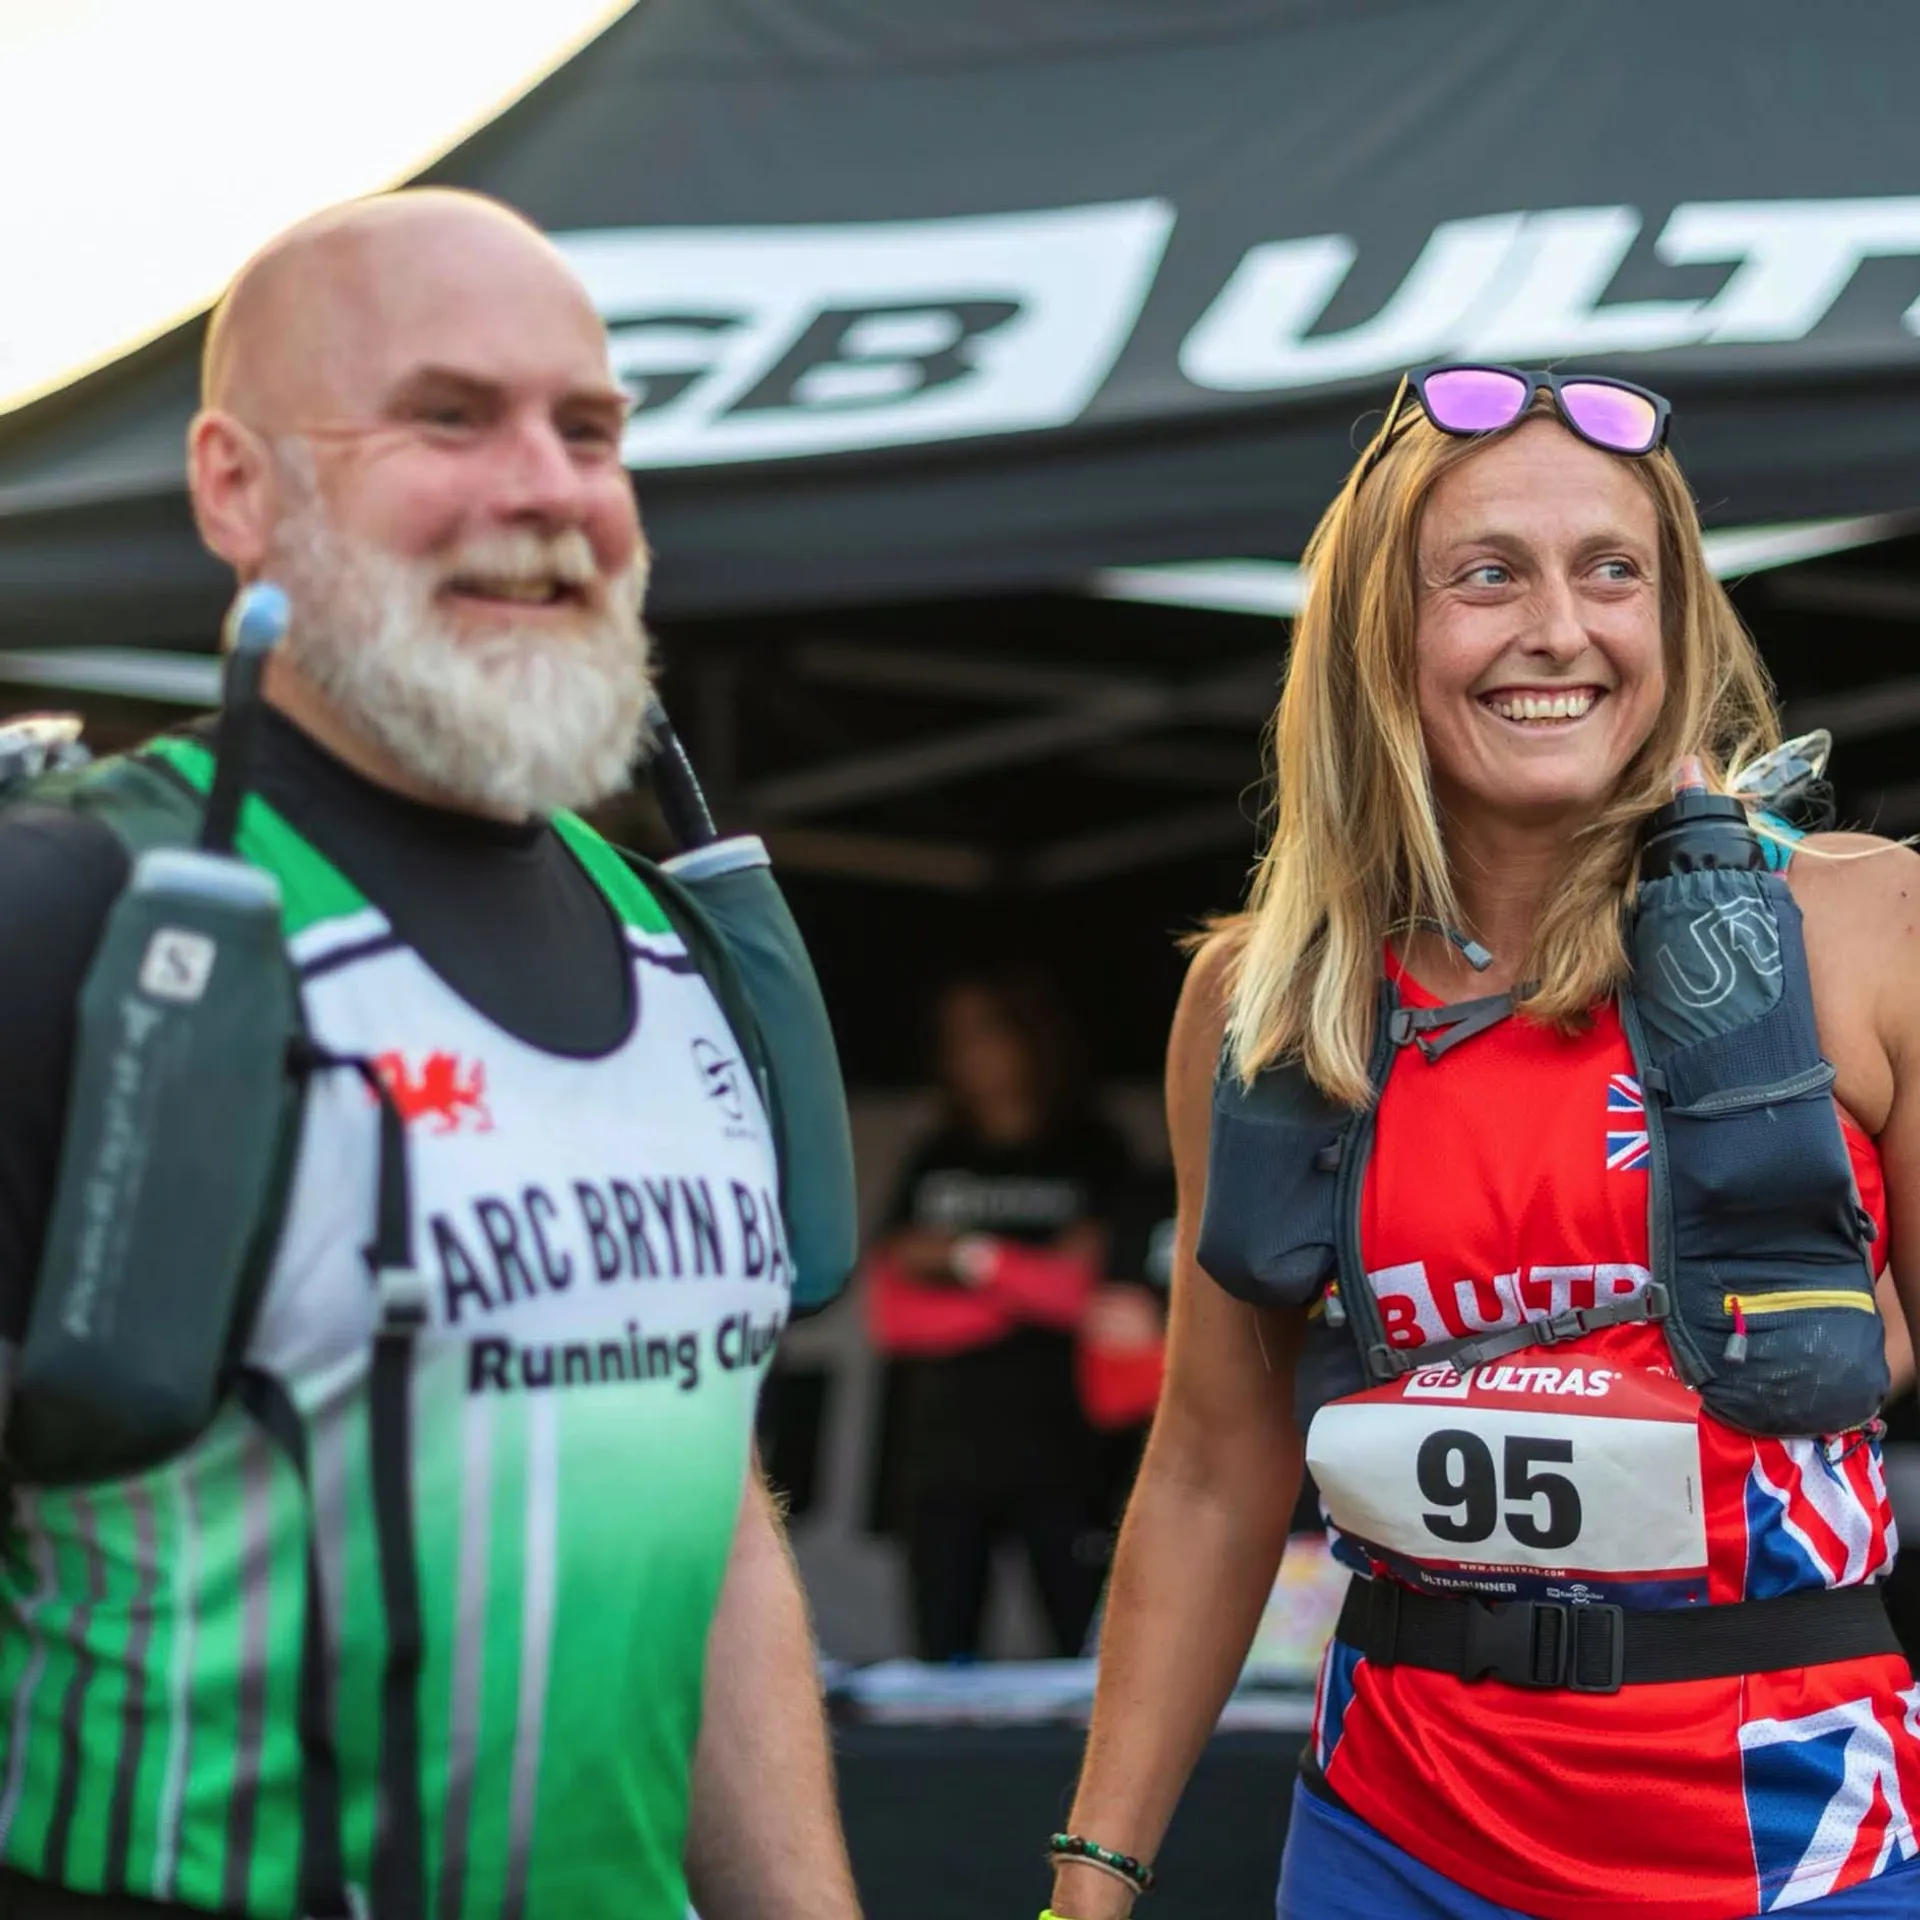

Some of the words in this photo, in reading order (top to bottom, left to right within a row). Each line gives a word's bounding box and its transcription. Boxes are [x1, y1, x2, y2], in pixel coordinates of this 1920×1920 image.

[1178, 198, 1920, 391] ULT
[430, 1183, 572, 1323] ARC
[573, 1177, 724, 1284] BRYN
[467, 1322, 698, 1392] Running
[1416, 1428, 1583, 1549] 95
[1420, 1571, 1518, 1593] ULTRARUNNER
